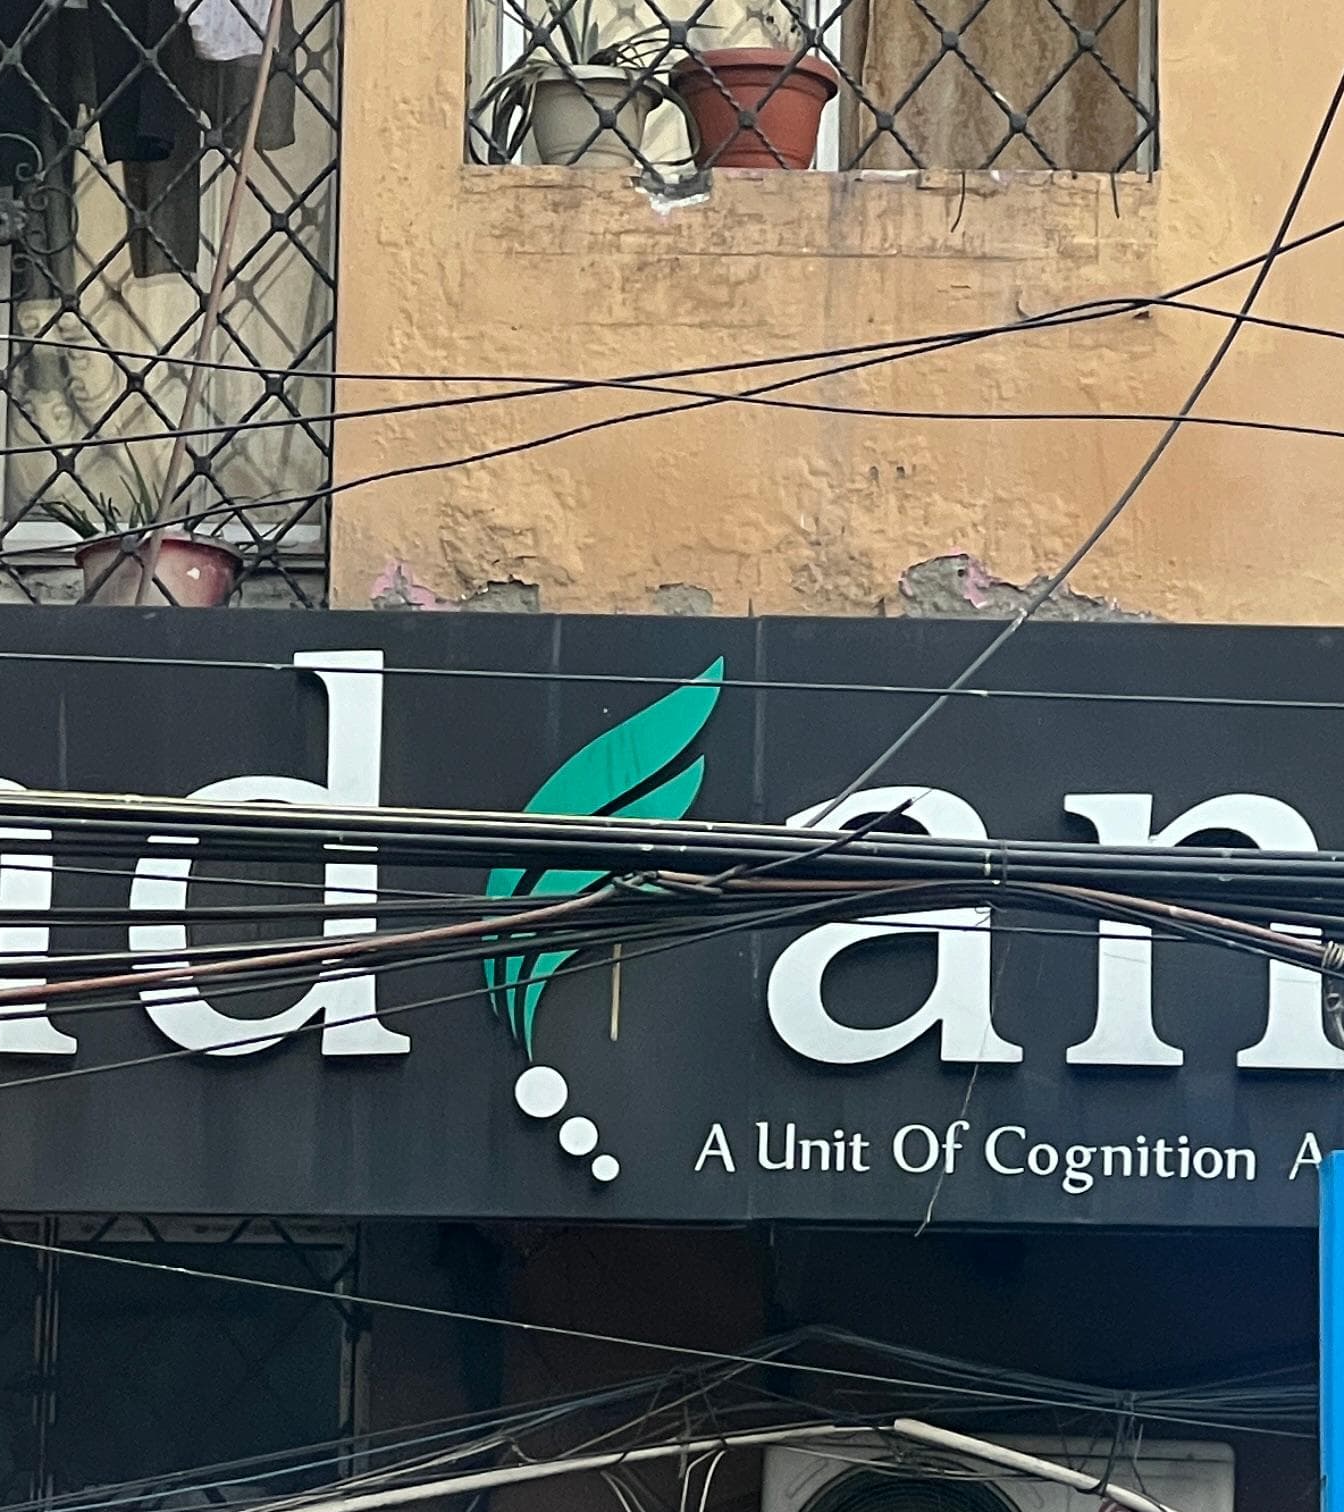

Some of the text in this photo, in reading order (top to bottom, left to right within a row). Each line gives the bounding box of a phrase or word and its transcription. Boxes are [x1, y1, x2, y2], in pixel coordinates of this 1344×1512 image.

[694, 1123, 736, 1172] A
[756, 1121, 871, 1172] Unit
[893, 1120, 970, 1174] Of
[984, 1125, 1257, 1194] Cognition
